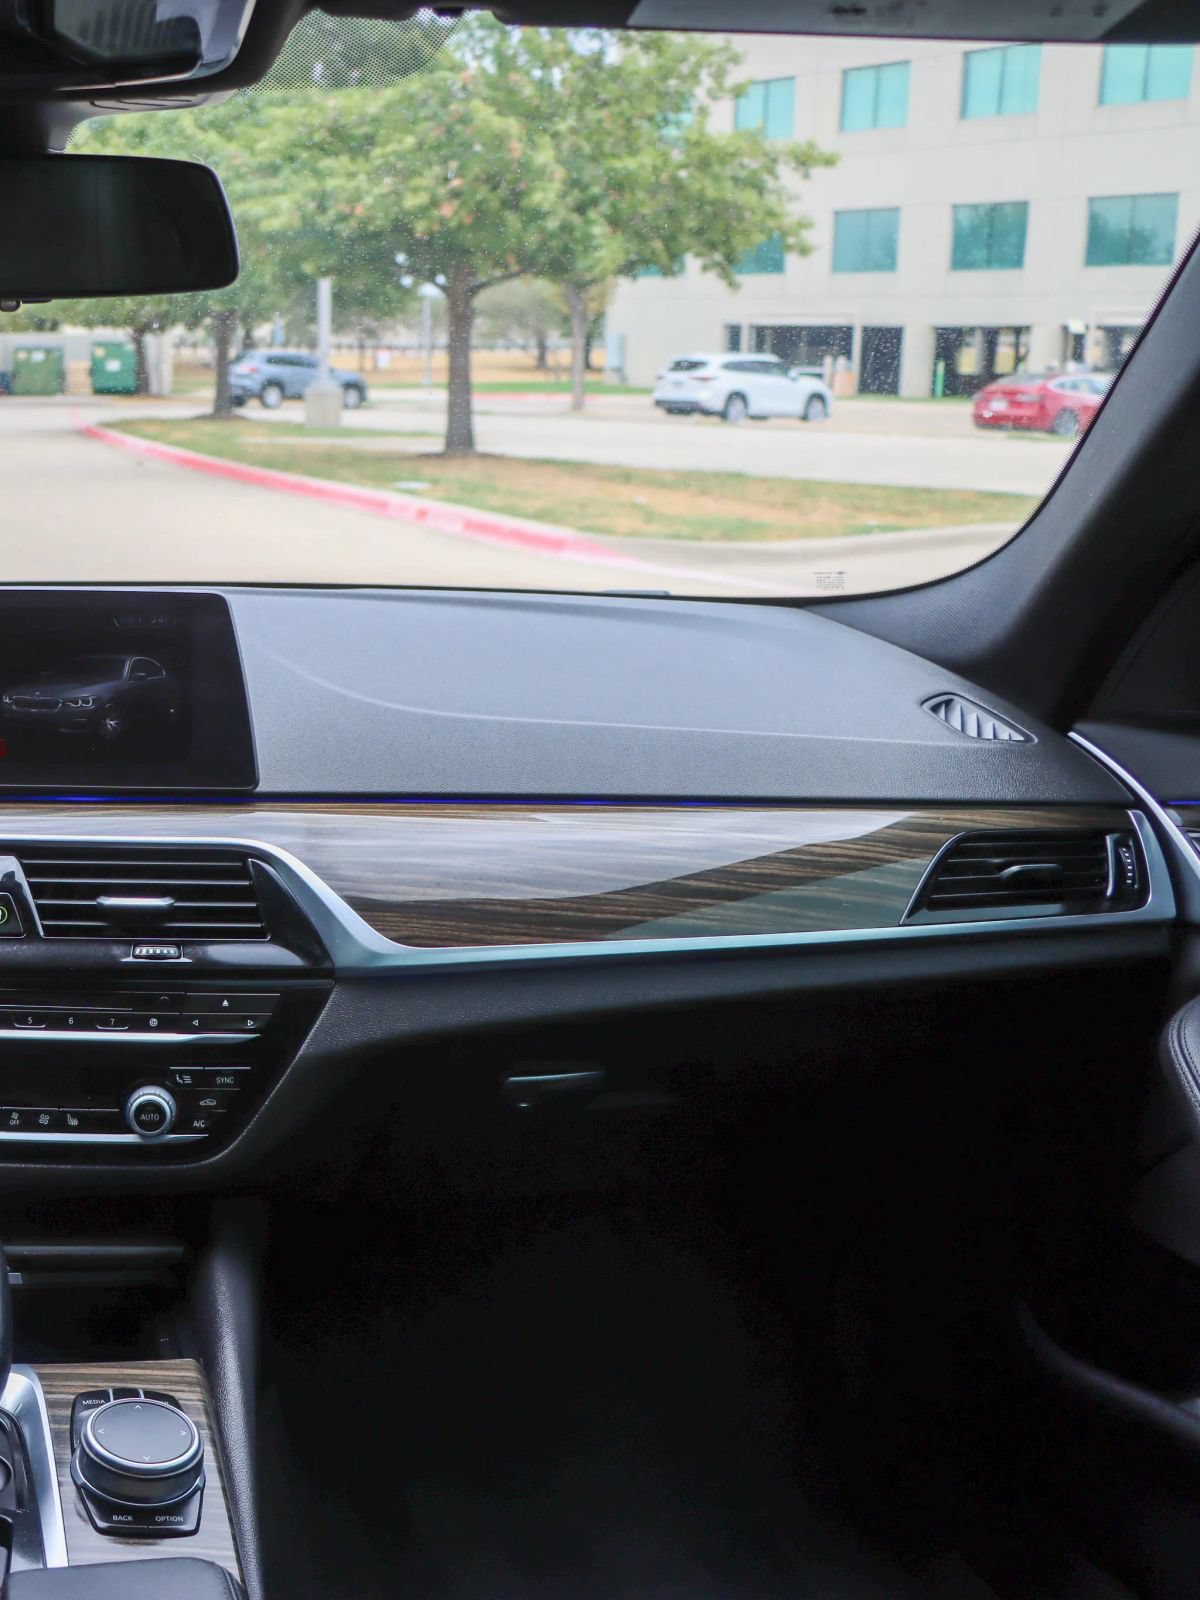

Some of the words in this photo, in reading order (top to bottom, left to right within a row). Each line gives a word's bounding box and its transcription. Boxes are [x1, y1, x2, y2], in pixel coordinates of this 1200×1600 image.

[27, 1017, 33, 1025] 5
[68, 1017, 74, 1025] 6
[110, 1018, 115, 1026] 7
[216, 1076, 235, 1085] SYNC
[140, 1113, 160, 1122] AUTO
[9, 1119, 20, 1127] OFF
[193, 1119, 206, 1128] A/C
[112, 1514, 133, 1522] BACK
[155, 1515, 184, 1523] OPTION
